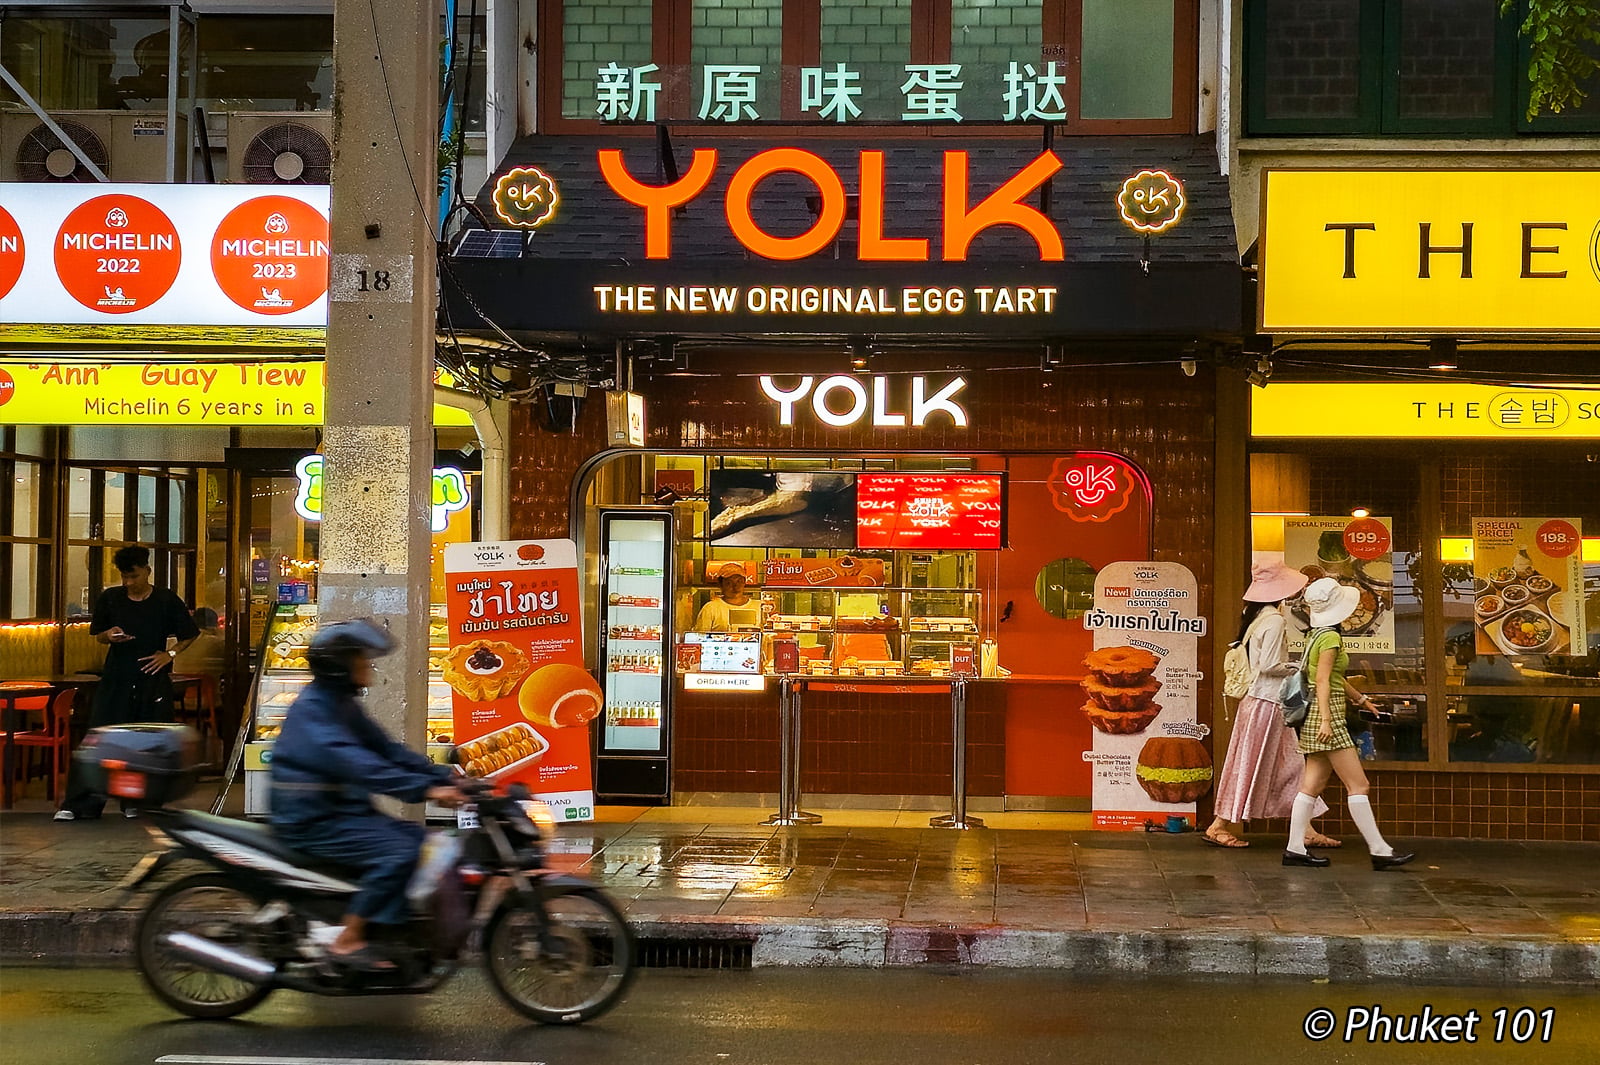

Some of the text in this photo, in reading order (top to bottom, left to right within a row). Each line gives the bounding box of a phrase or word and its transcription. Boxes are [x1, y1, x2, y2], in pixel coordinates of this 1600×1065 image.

[596, 61, 1067, 122] 新原味蛋挞
[598, 148, 1065, 261] YOLK
[63, 233, 173, 250] MICHELIN
[222, 239, 330, 256] MICHELIN
[1325, 222, 1568, 279] THE
[96, 258, 140, 273] 2022
[252, 264, 297, 279] 2023
[356, 269, 391, 292] 18
[594, 286, 1057, 313] THE NEW ORIGINAL EGG TART
[142, 362, 217, 392] Guay
[231, 362, 306, 385] Tiew
[85, 398, 316, 419] Michelin 6 years in a
[759, 375, 968, 427] YOLK
[1412, 402, 1480, 419] THE
[1499, 397, 1558, 424] 솥밥
[858, 500, 896, 509] OLK
[1477, 521, 1524, 530] SPECIAL
[1477, 529, 1514, 538] PRICE!
[1347, 532, 1388, 544] 199.-
[1540, 533, 1576, 544] 198.-
[473, 552, 505, 561] YOLK
[1133, 571, 1159, 579] YOLK
[457, 578, 491, 594] เมนูใหม่
[1106, 588, 1129, 597] New!
[469, 581, 559, 618] ชาไทย
[461, 619, 499, 633] เข้มข้น
[1087, 609, 1203, 632] เจ้าแรกในไทย
[728, 678, 750, 686] HERE
